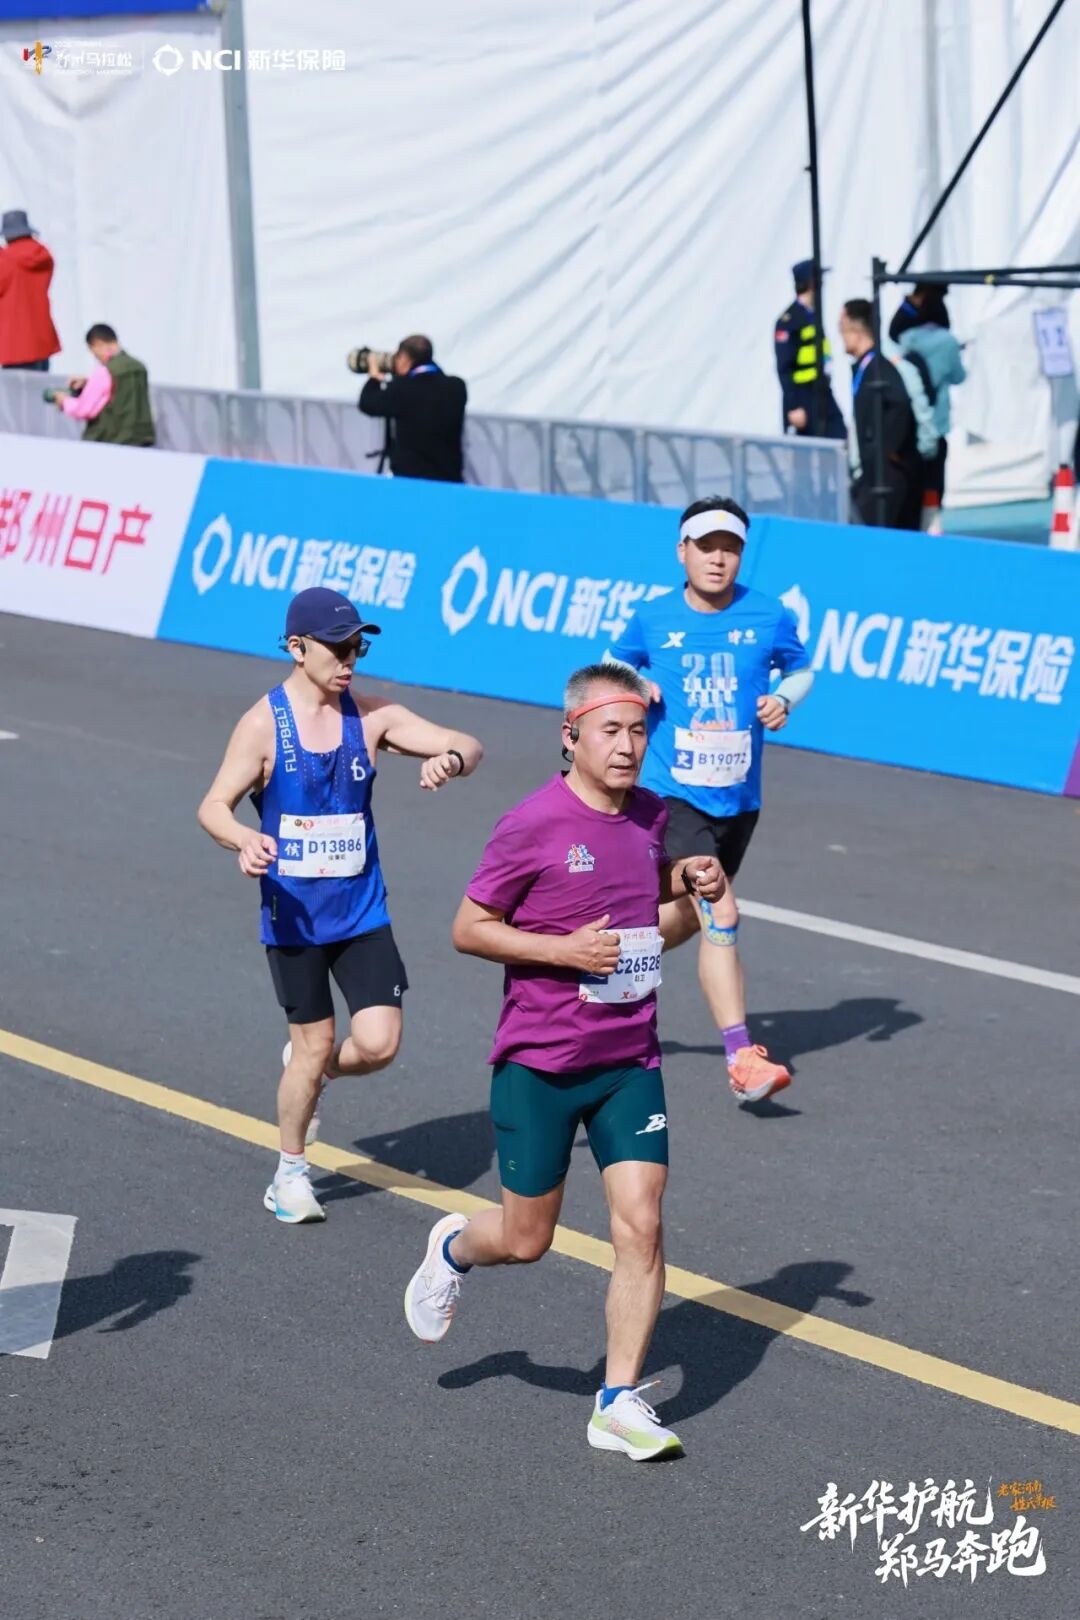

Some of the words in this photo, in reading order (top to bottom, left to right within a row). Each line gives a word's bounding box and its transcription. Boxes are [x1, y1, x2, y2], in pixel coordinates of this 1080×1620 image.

[0, 487, 153, 575] 郑州日产
[230, 532, 299, 590] NCI
[291, 538, 416, 609] 新华保险
[487, 557, 568, 633] NCI
[561, 576, 675, 643] 新华
[812, 608, 904, 680] NCI
[897, 618, 1075, 705] 新华保险
[273, 705, 297, 773] FLIPBELT
[308, 838, 362, 854] D13886
